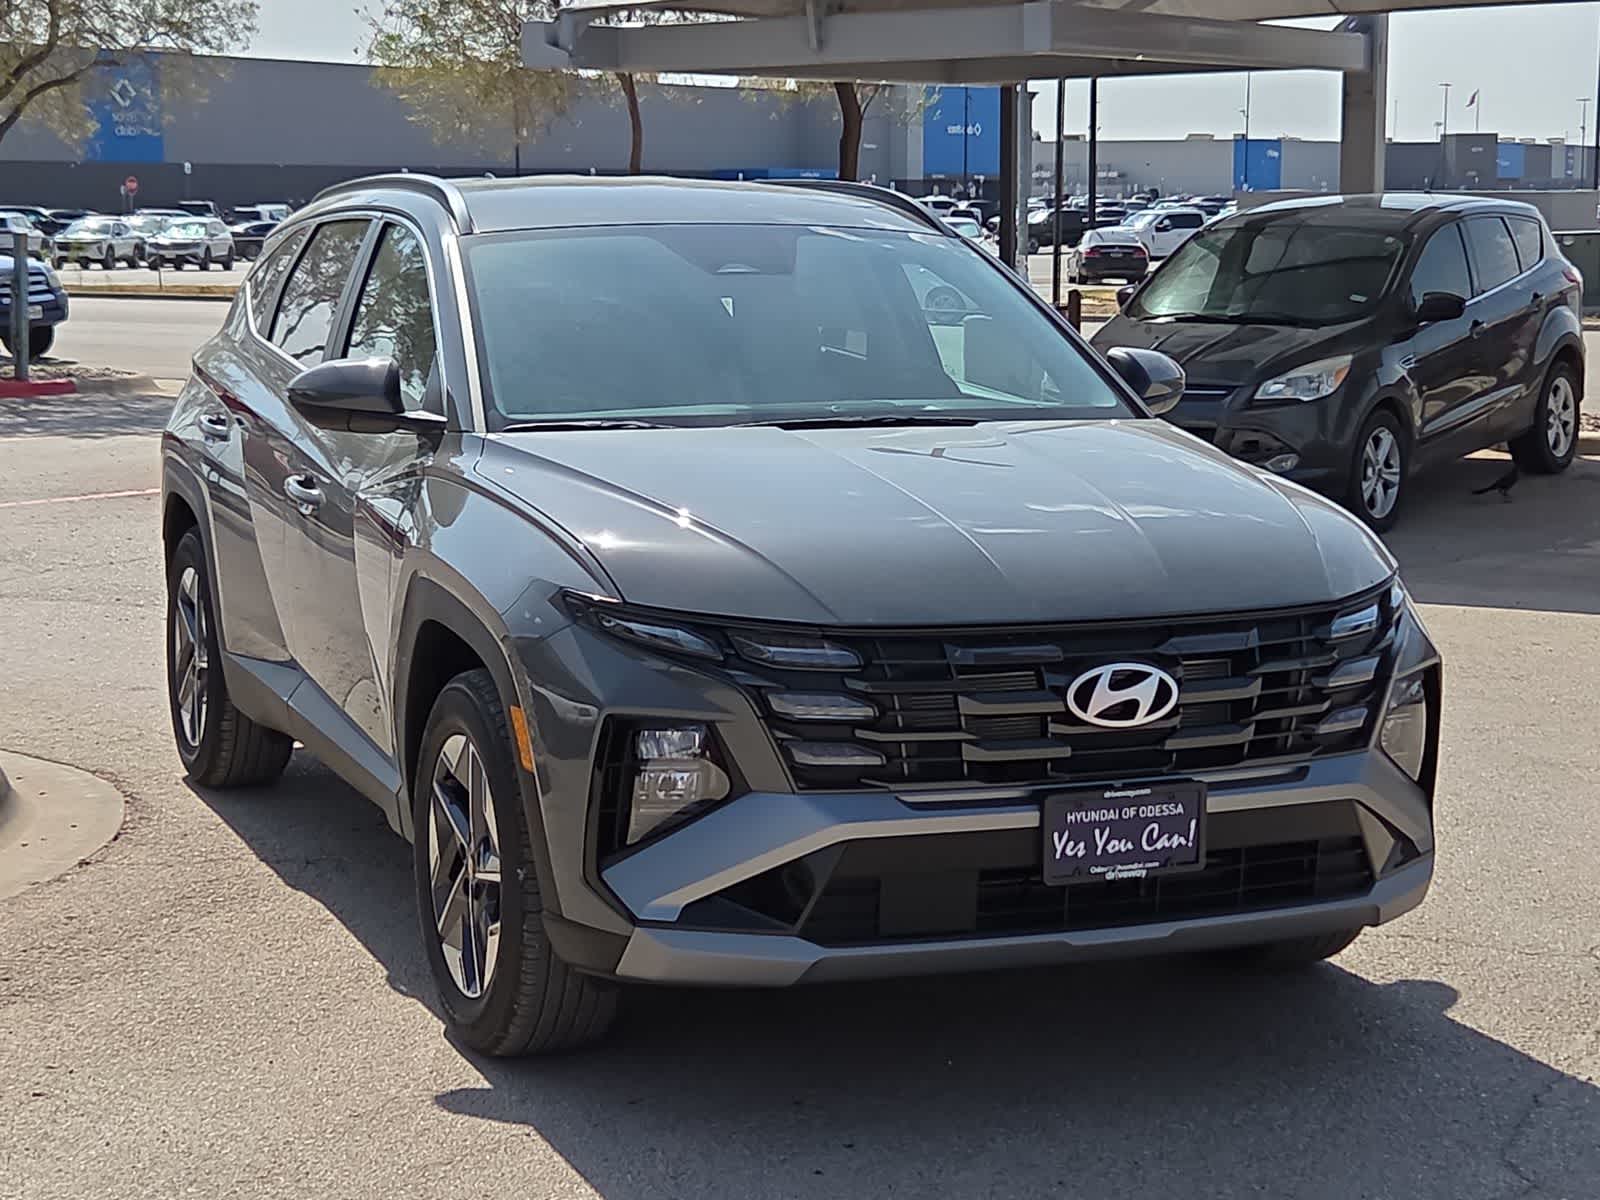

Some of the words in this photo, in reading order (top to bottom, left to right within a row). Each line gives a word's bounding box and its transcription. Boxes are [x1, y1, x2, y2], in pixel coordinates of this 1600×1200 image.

[1067, 809, 1119, 824] HYUNDAI
[1121, 806, 1137, 819] OF
[1139, 802, 1184, 818] ODESSA
[1053, 829, 1086, 860] Yes
[1094, 826, 1134, 857] You
[1141, 818, 1197, 852] Can!
